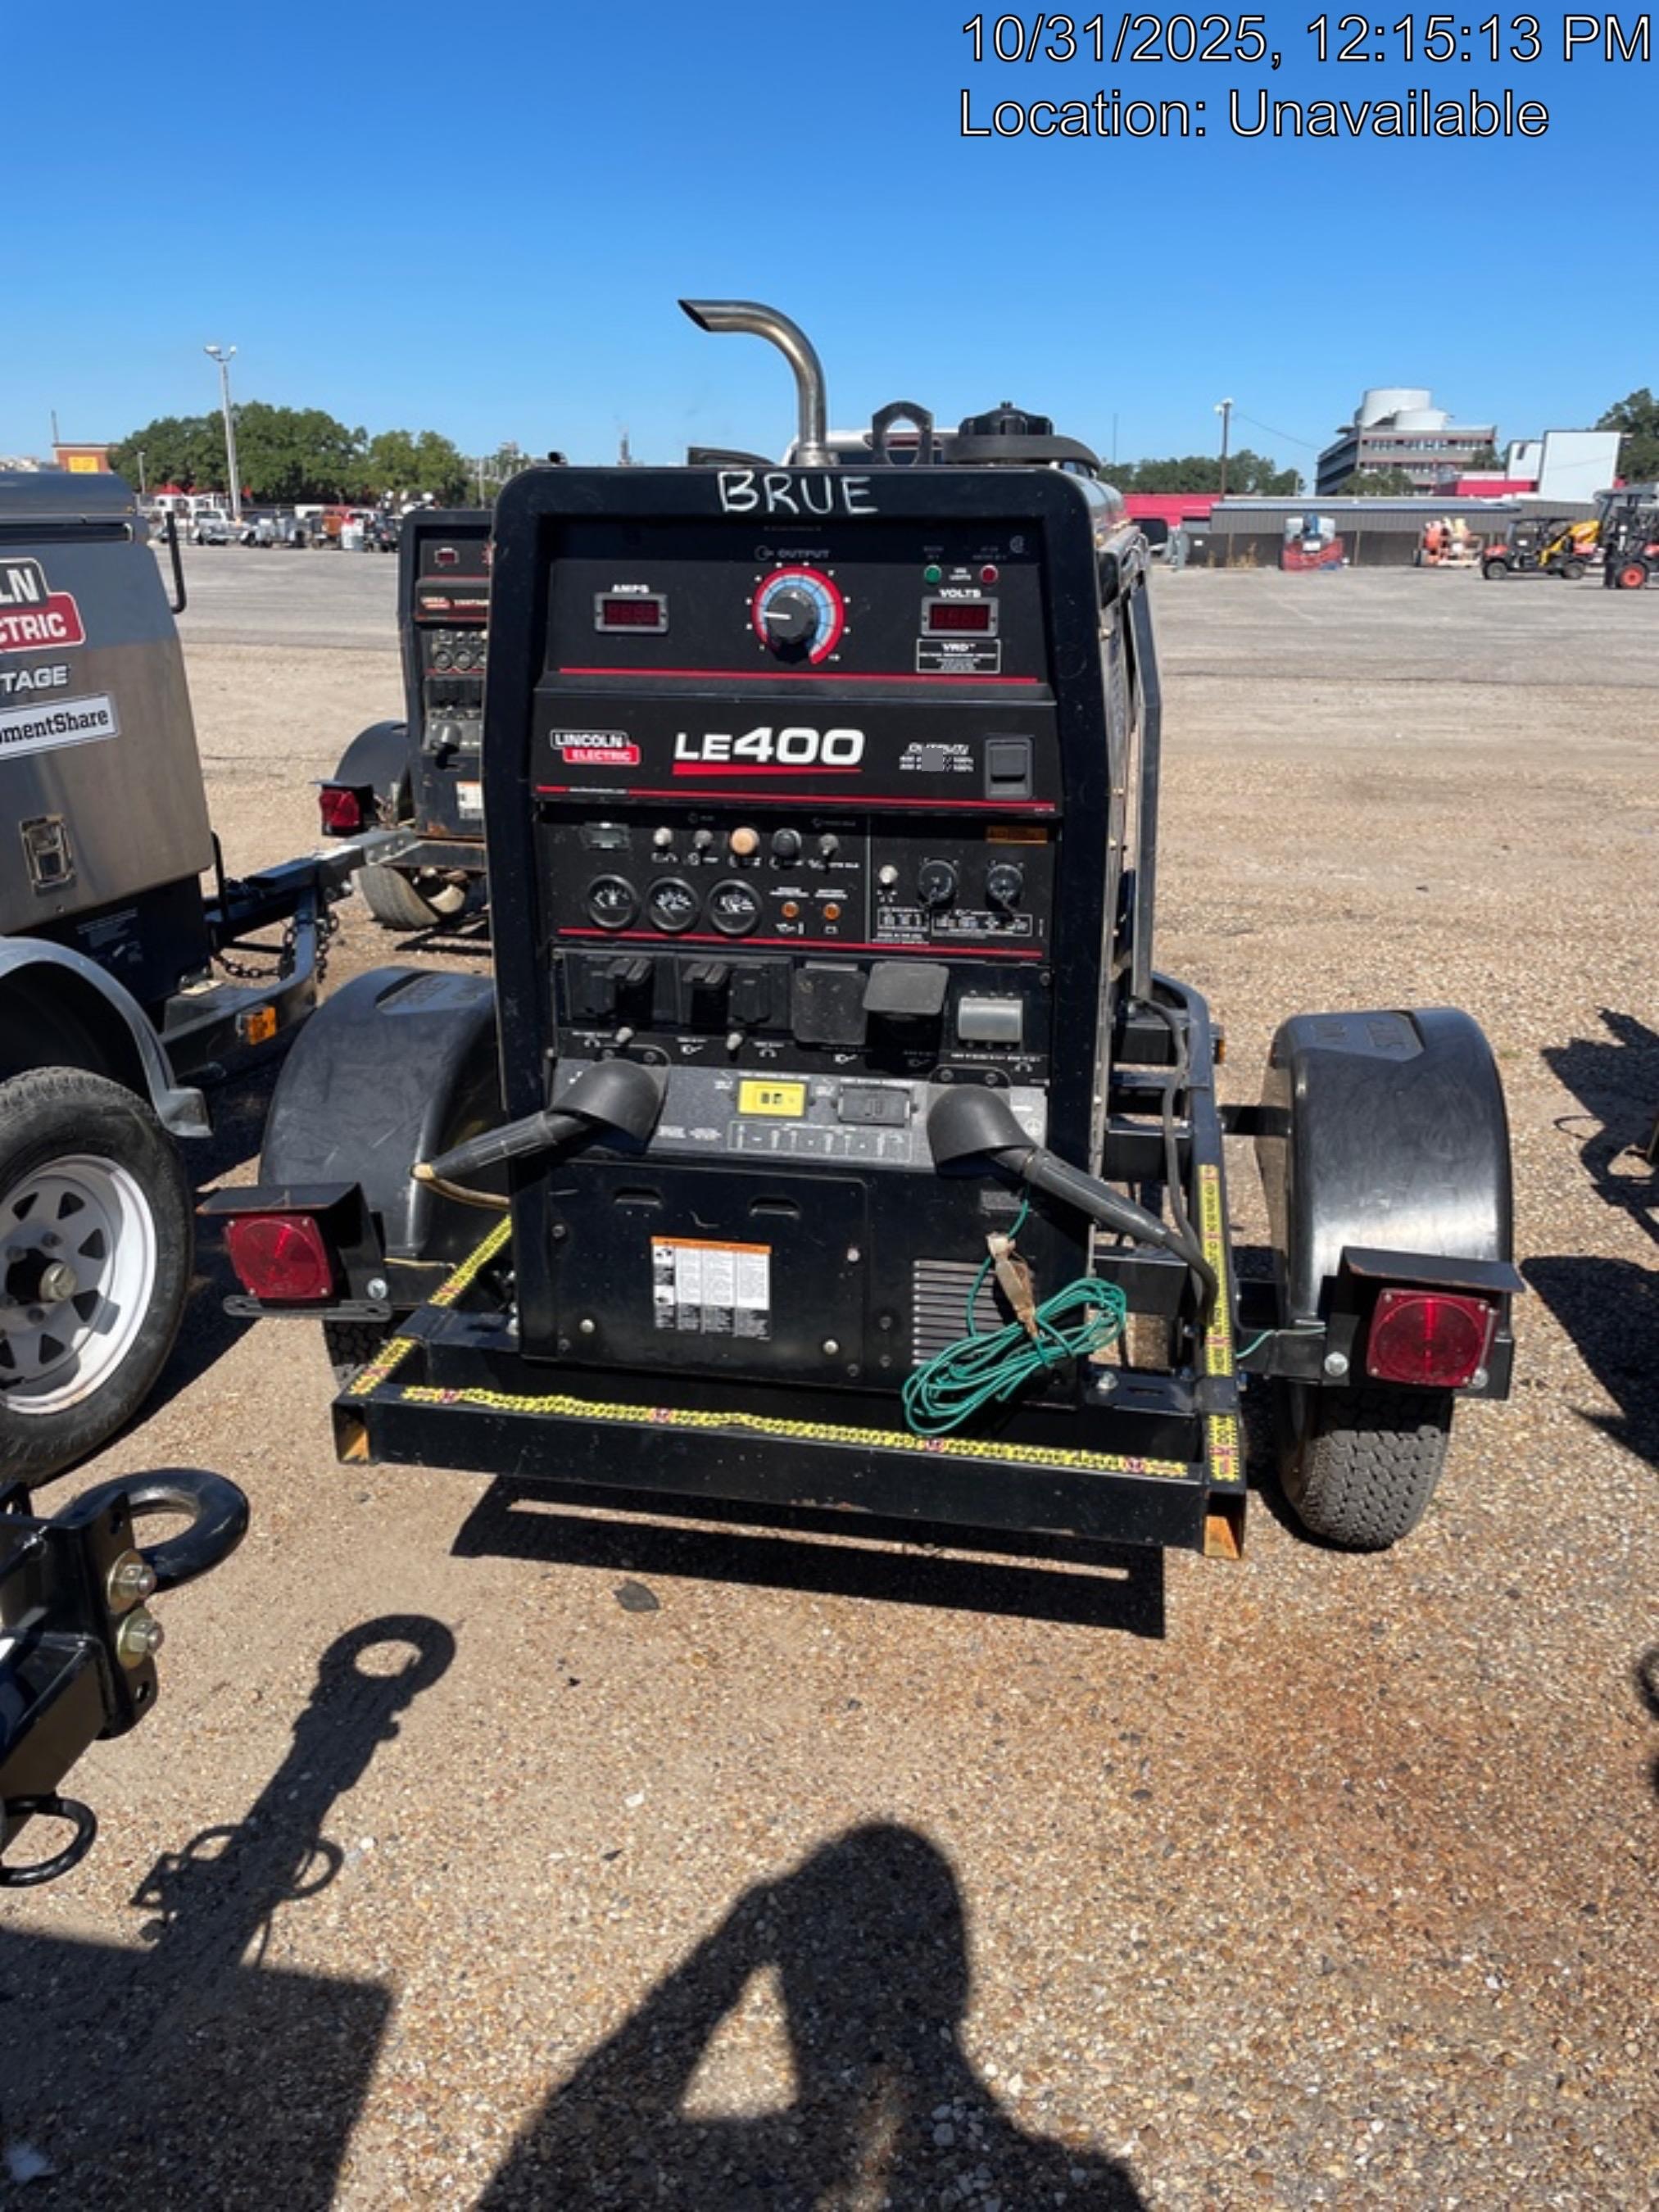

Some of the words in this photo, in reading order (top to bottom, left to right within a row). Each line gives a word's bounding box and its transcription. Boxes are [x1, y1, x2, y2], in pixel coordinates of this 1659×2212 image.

[717, 469, 879, 515] BRUE
[612, 583, 650, 594] AMPS
[939, 588, 981, 599] VOLTS
[0, 664, 68, 693] TAGE
[0, 709, 109, 745] mentShare
[555, 733, 623, 748] LINCOLN
[674, 726, 865, 766] LE400
[571, 748, 631, 763] ELECTRIC
